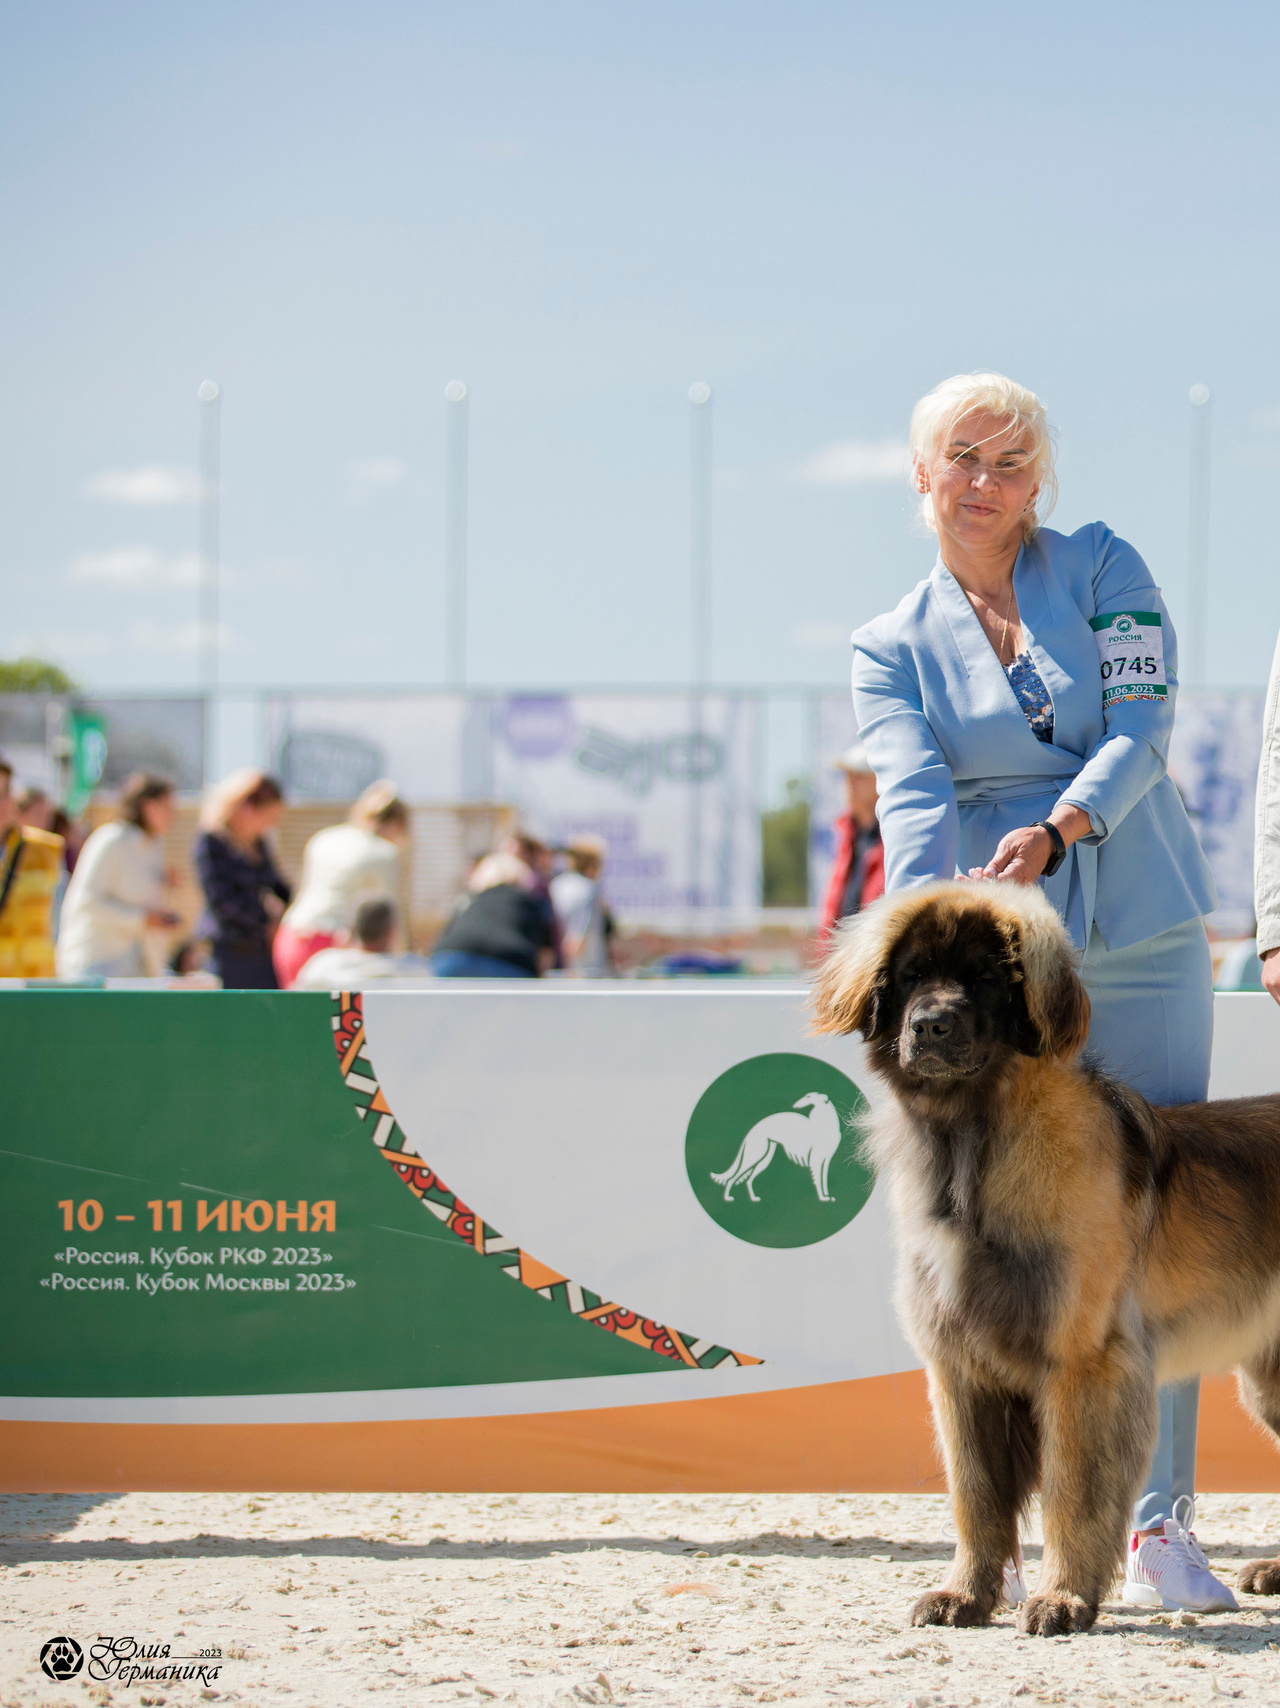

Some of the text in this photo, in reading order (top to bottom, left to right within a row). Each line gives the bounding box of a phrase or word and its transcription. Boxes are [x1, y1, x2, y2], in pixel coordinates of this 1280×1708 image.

[1109, 634, 1142, 643] РОССИЯ
[1101, 657, 1157, 679] 0745
[1106, 685, 1154, 698] 11.06.2023
[58, 1199, 104, 1231] 10
[147, 1199, 182, 1231] 11
[197, 1199, 336, 1232] ИЮНЯ
[54, 1246, 333, 1270] «Россия. Кубок РКФ 2023»
[39, 1273, 357, 1296] «Россия. Кубок Москвы 2023»
